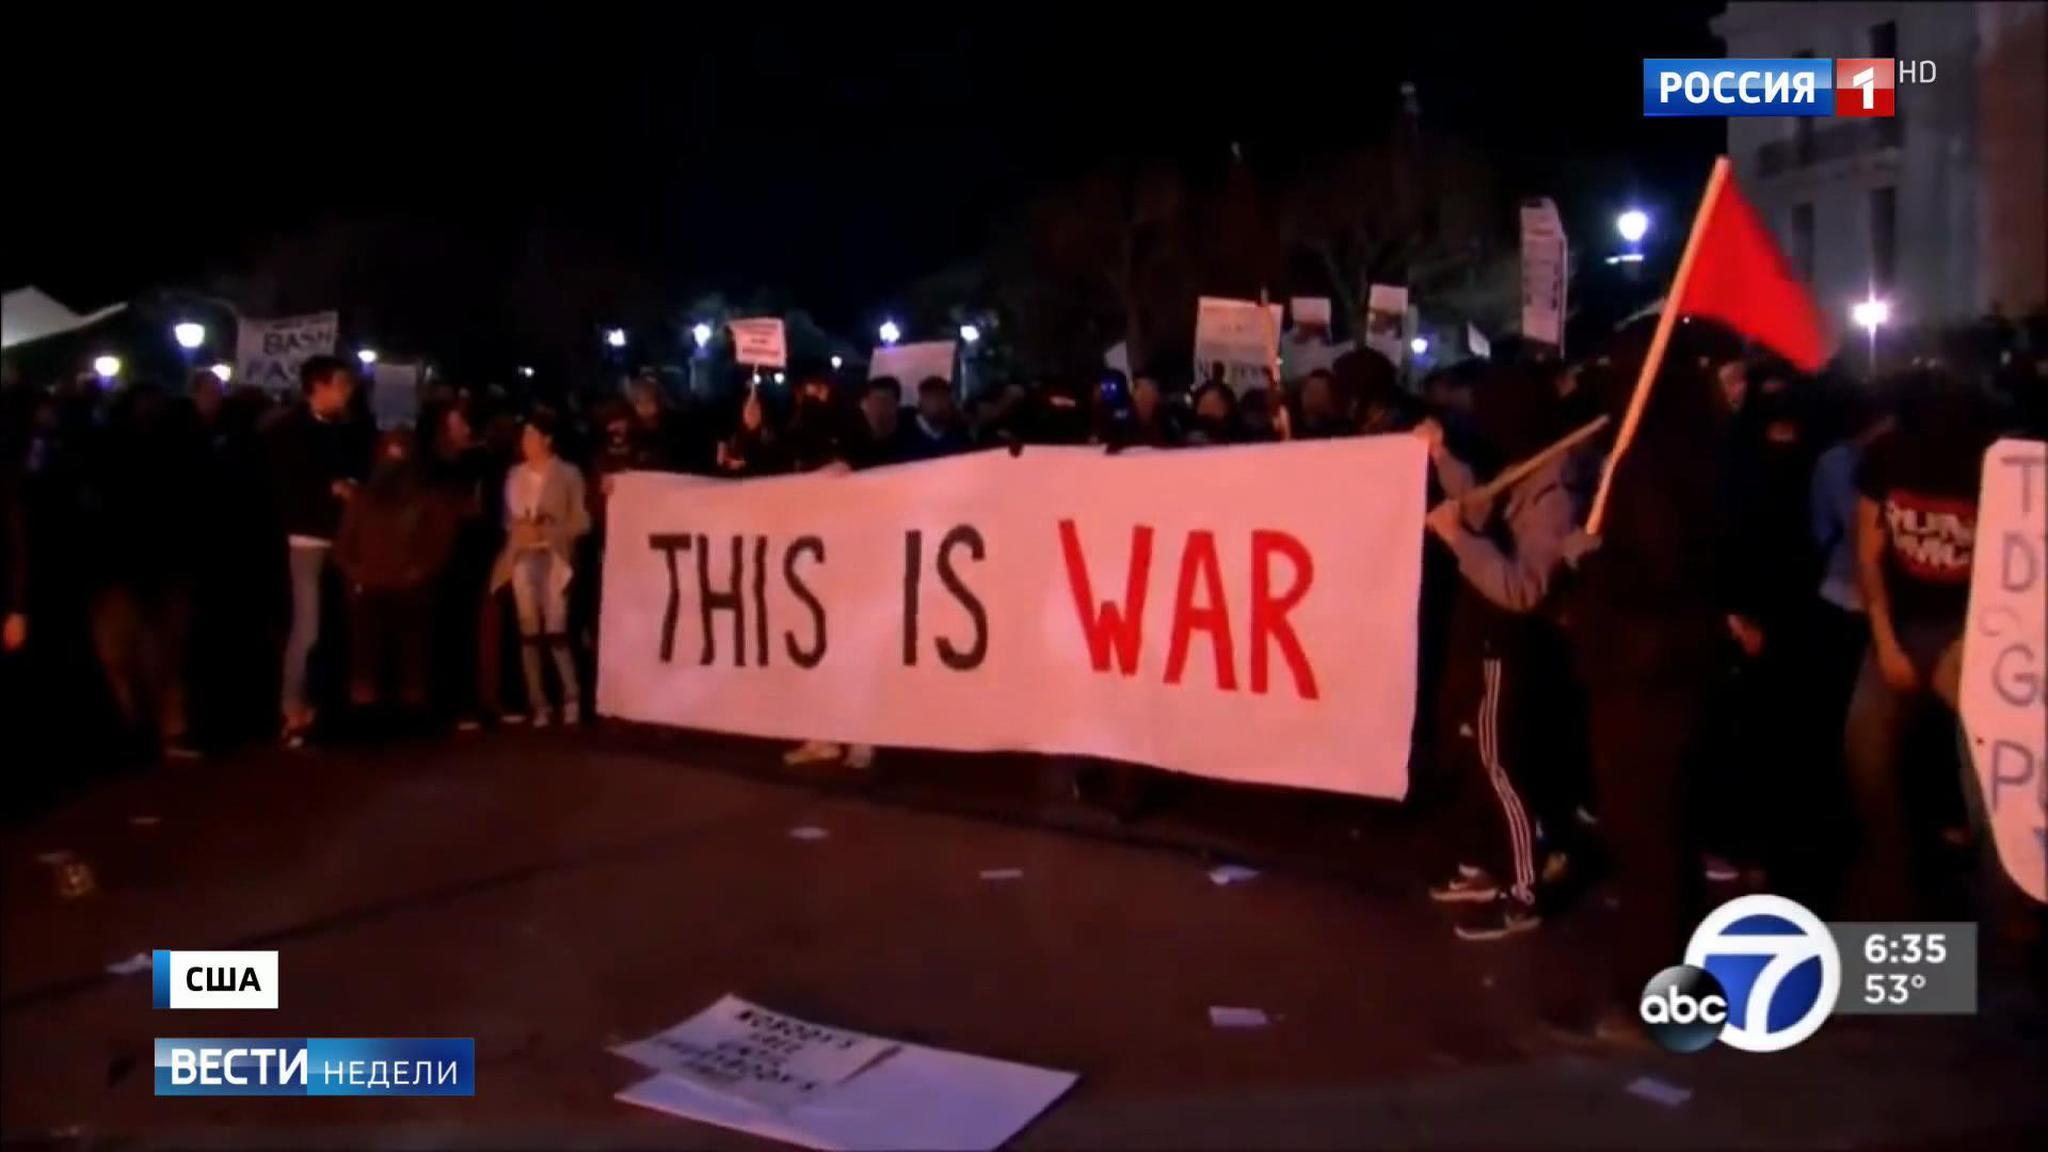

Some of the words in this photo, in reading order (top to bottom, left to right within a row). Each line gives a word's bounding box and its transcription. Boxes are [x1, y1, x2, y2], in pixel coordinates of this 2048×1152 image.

[648, 533, 827, 669] THIS
[903, 524, 989, 670] IS
[1058, 518, 1319, 701] WAR
